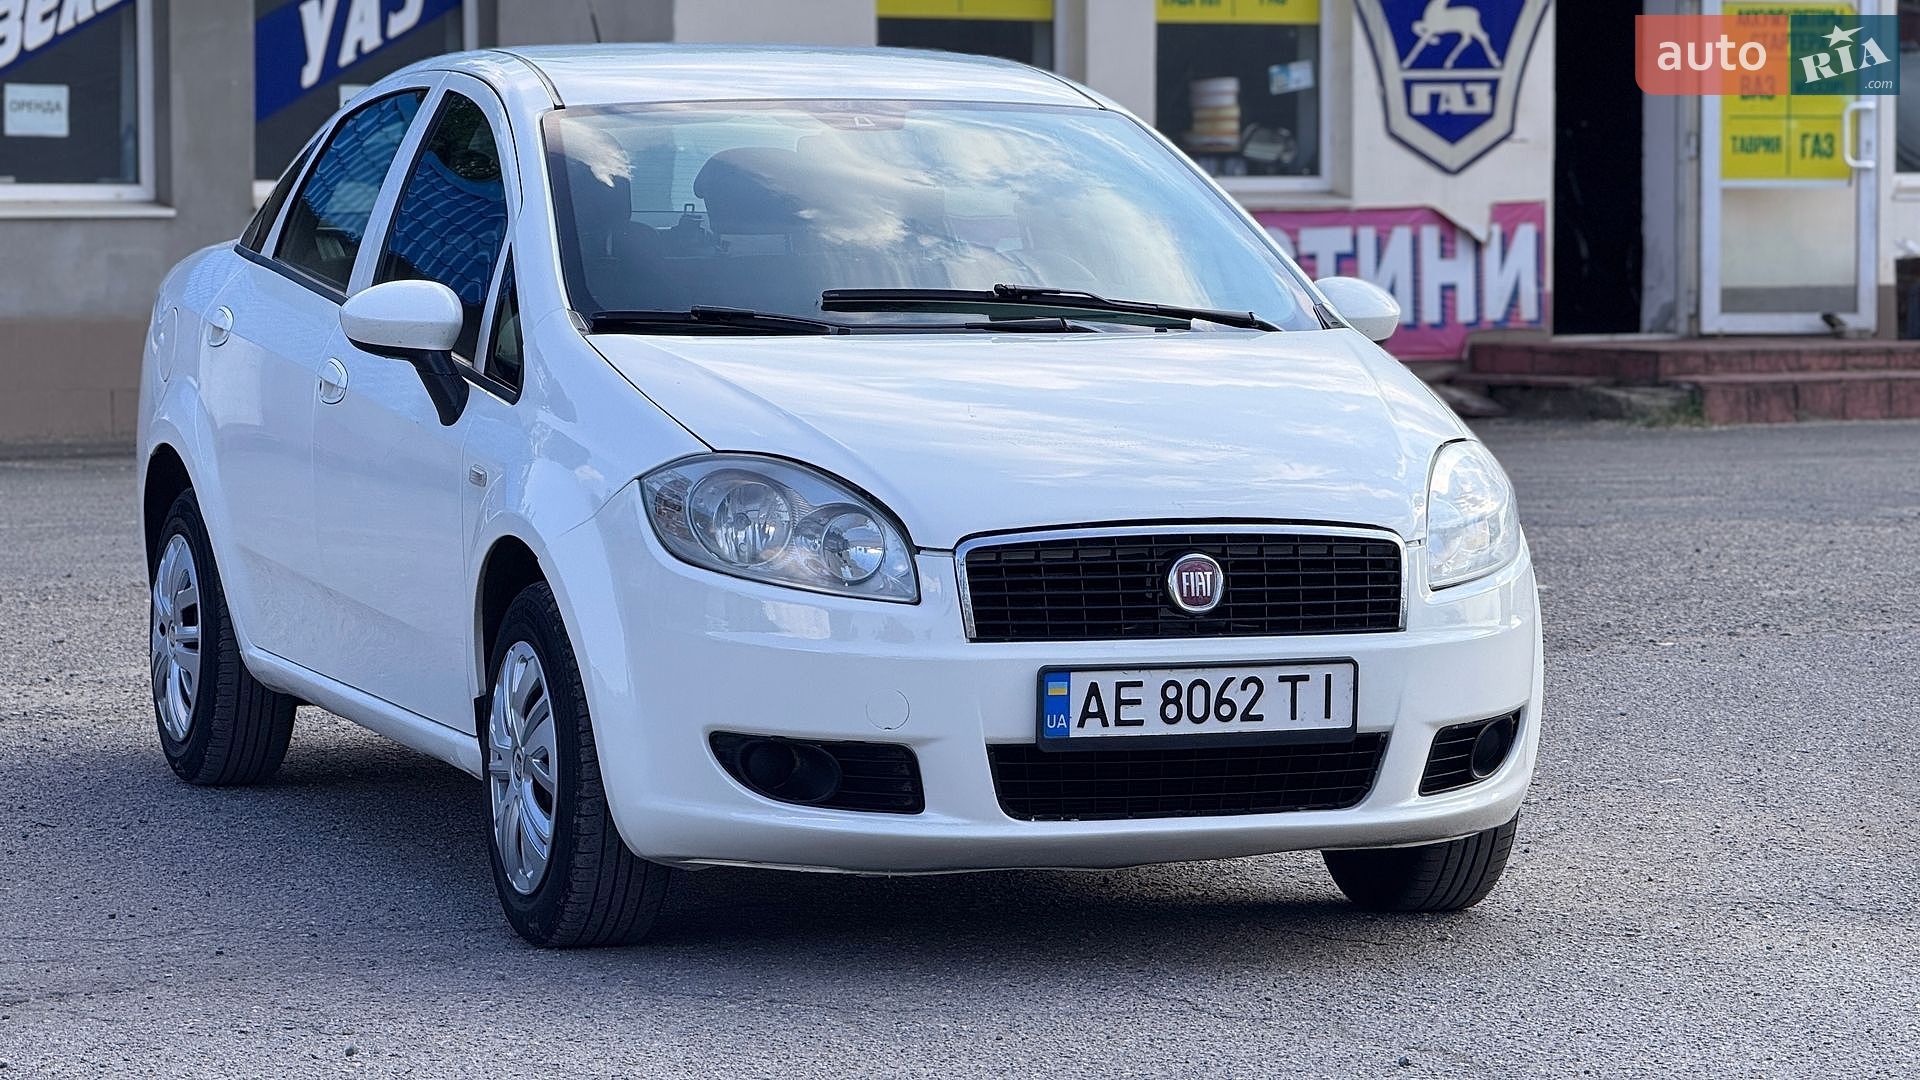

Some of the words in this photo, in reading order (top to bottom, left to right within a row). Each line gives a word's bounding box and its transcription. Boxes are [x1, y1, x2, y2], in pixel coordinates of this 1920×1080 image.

[1411, 83, 1492, 116] ГАЗ
[1800, 133, 1835, 159] ГАЗ
[1182, 571, 1212, 597] FIAT
[1077, 681, 1145, 728] AE
[1159, 676, 1265, 725] 8062
[1047, 714, 1067, 729] UA
